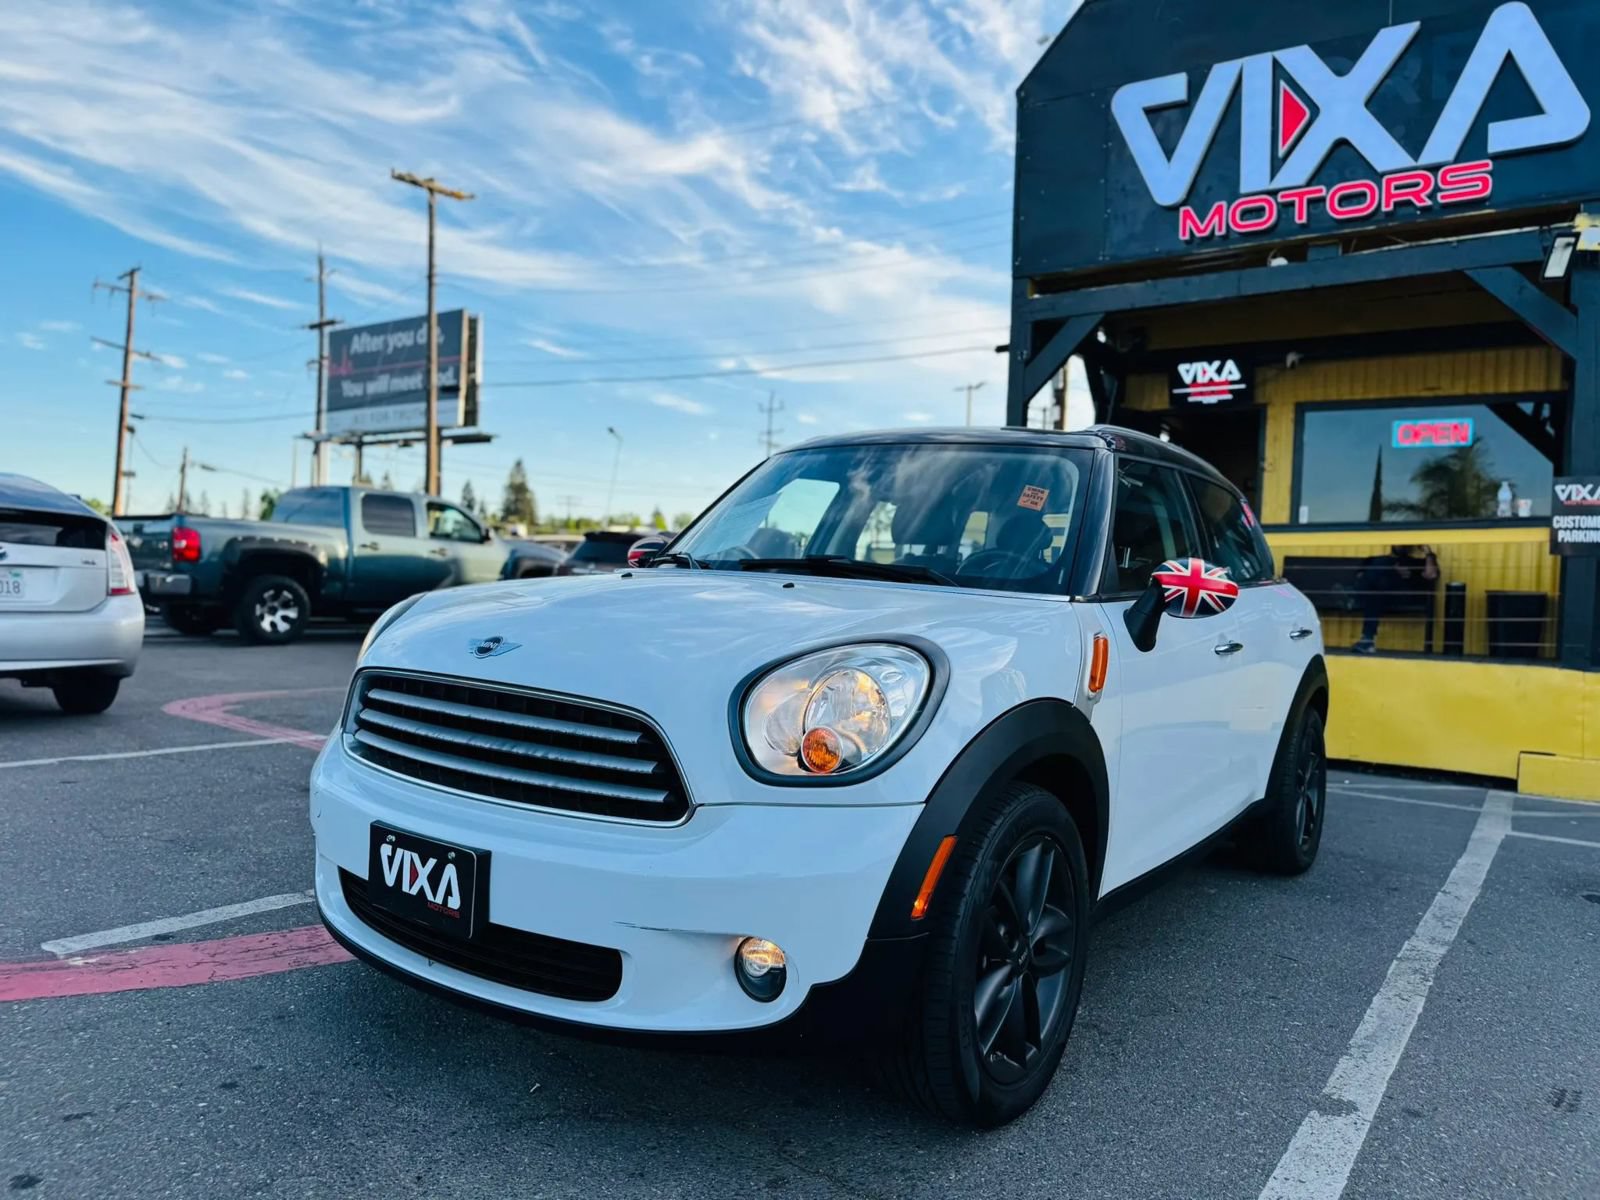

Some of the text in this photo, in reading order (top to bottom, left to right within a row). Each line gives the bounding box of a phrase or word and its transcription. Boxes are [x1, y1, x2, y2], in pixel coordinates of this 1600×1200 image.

[1111, 1, 1591, 207] VIXA
[1179, 160, 1493, 241] MOTORS
[350, 331, 385, 355] After
[386, 329, 415, 355] you
[1177, 359, 1241, 385] VIXA
[1397, 421, 1470, 445] OPEN
[1554, 484, 1600, 501] VIX
[380, 843, 460, 910] VIXA
